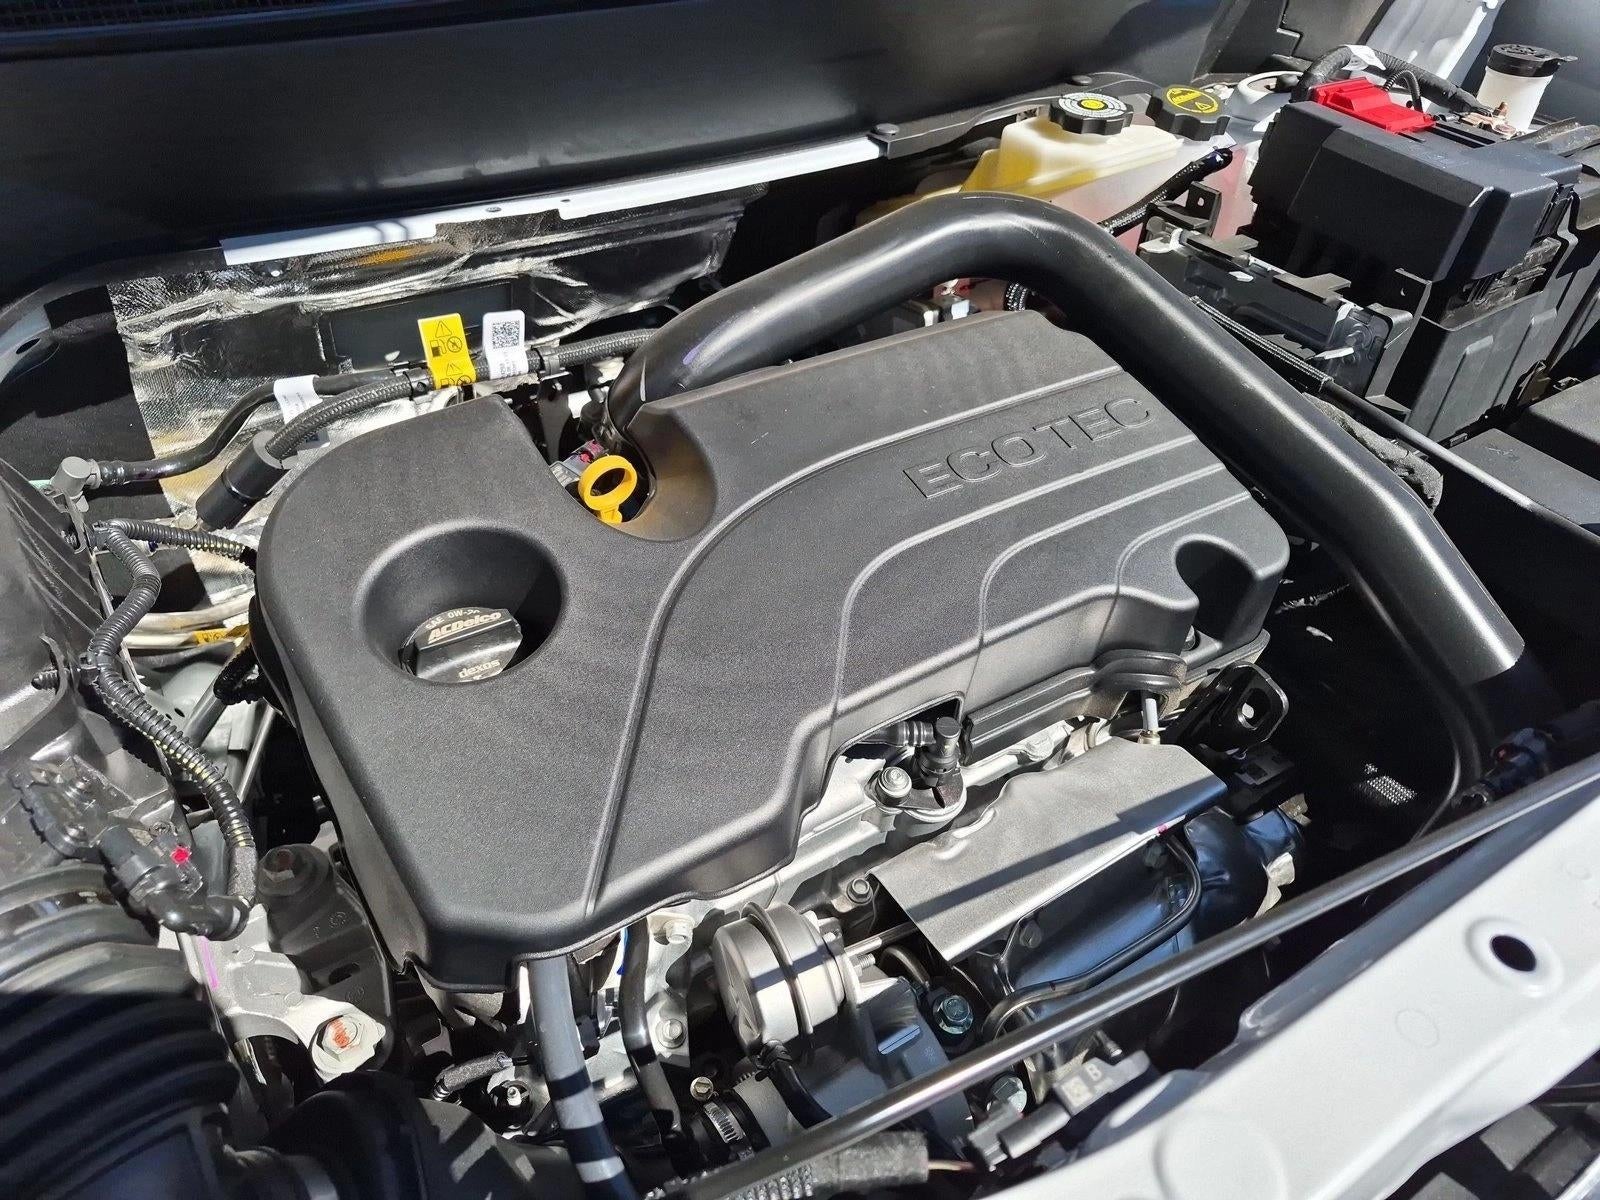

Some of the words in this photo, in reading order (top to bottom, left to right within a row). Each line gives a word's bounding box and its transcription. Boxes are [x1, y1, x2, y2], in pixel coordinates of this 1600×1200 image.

[903, 398, 1151, 498] ECOTEC
[426, 617, 445, 630] SAE
[428, 612, 502, 643] ACDelco
[459, 660, 501, 678] dexos
